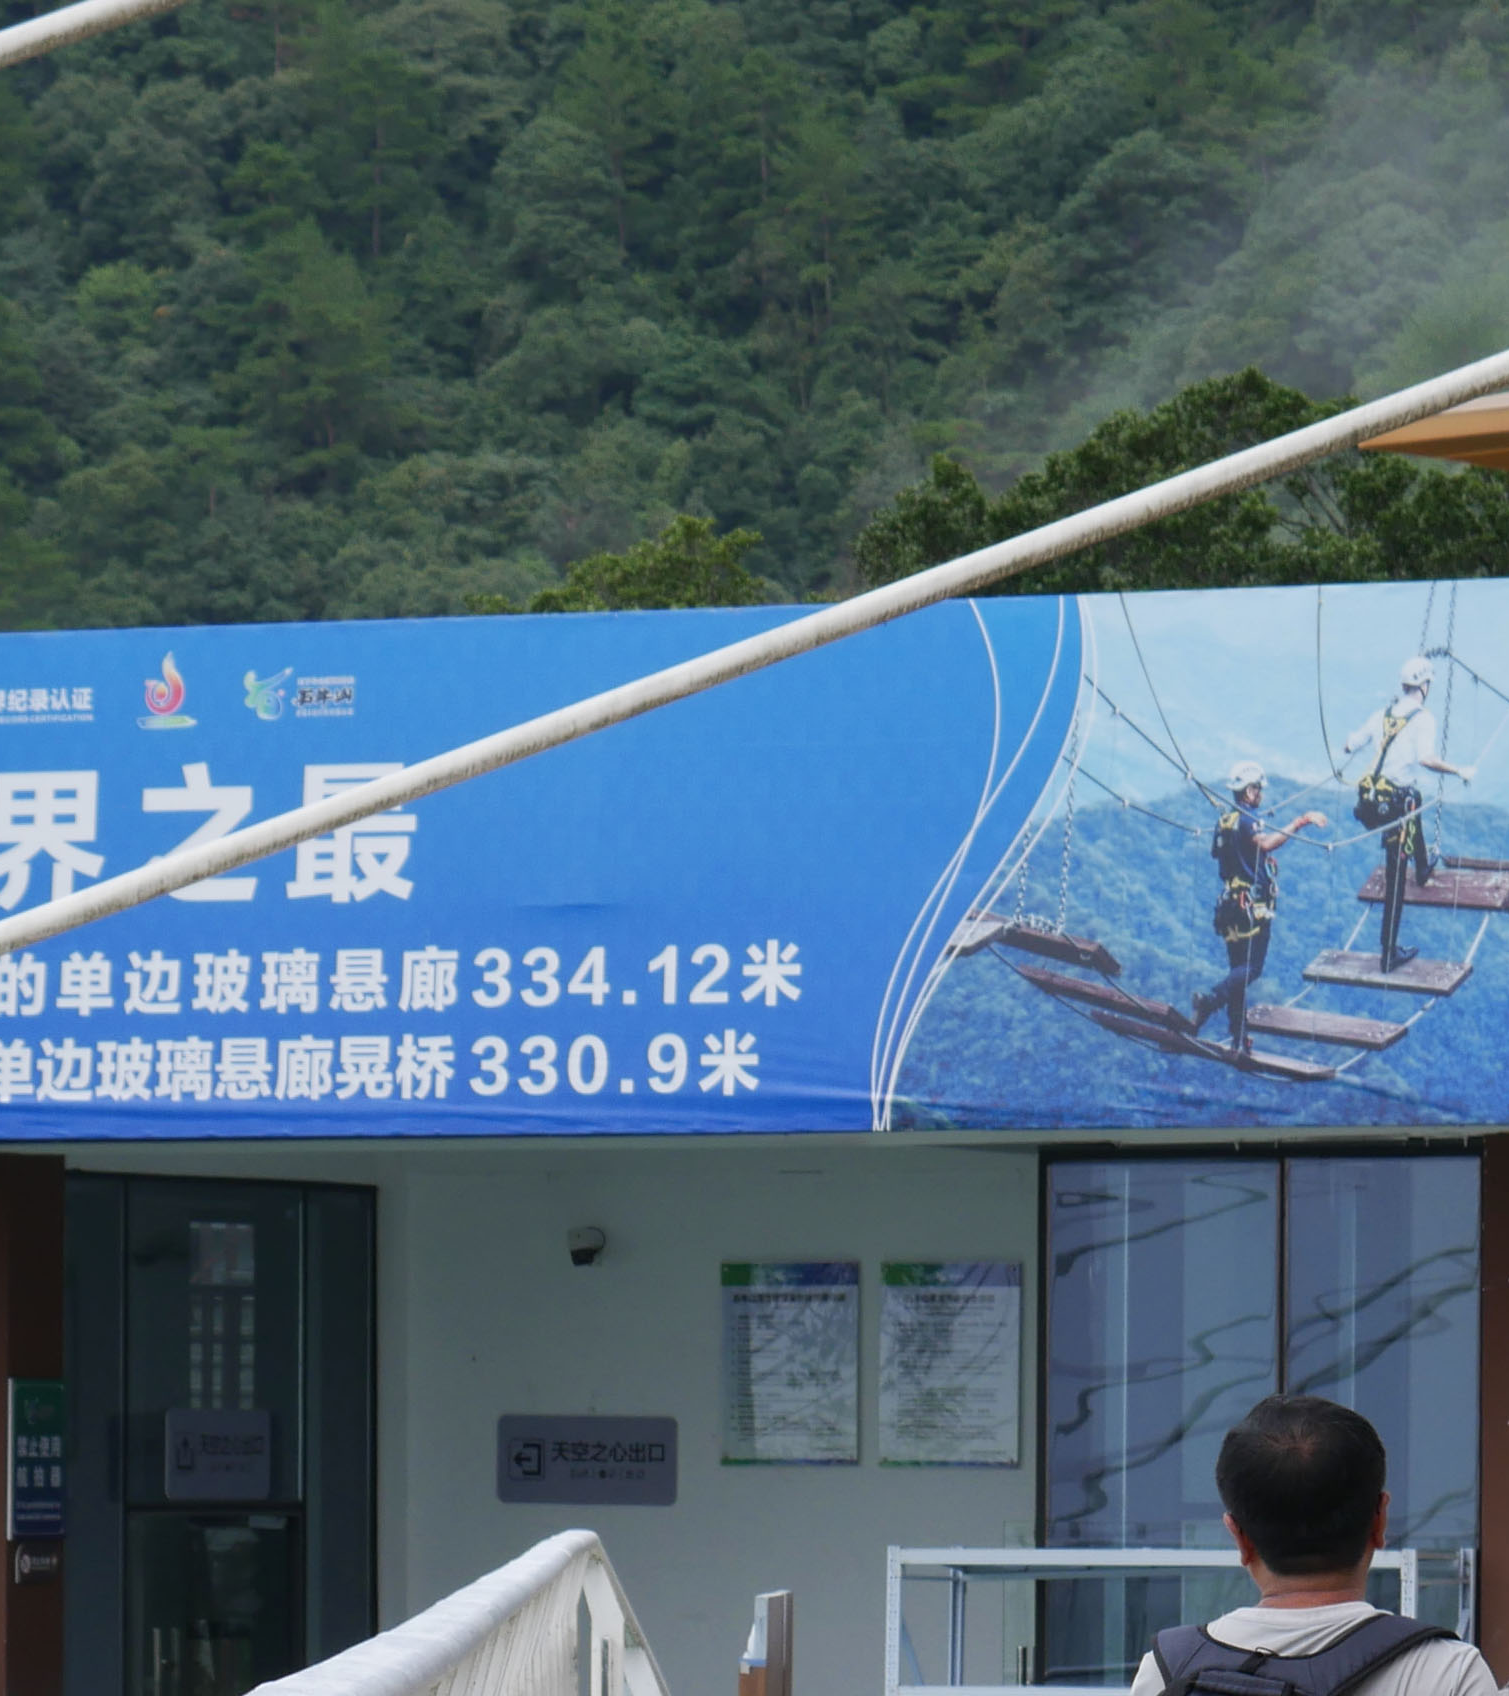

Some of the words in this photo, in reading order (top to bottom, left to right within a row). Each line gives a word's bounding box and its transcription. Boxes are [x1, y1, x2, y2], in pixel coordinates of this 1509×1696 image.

[550, 1440, 666, 1463] 天空之心出口
